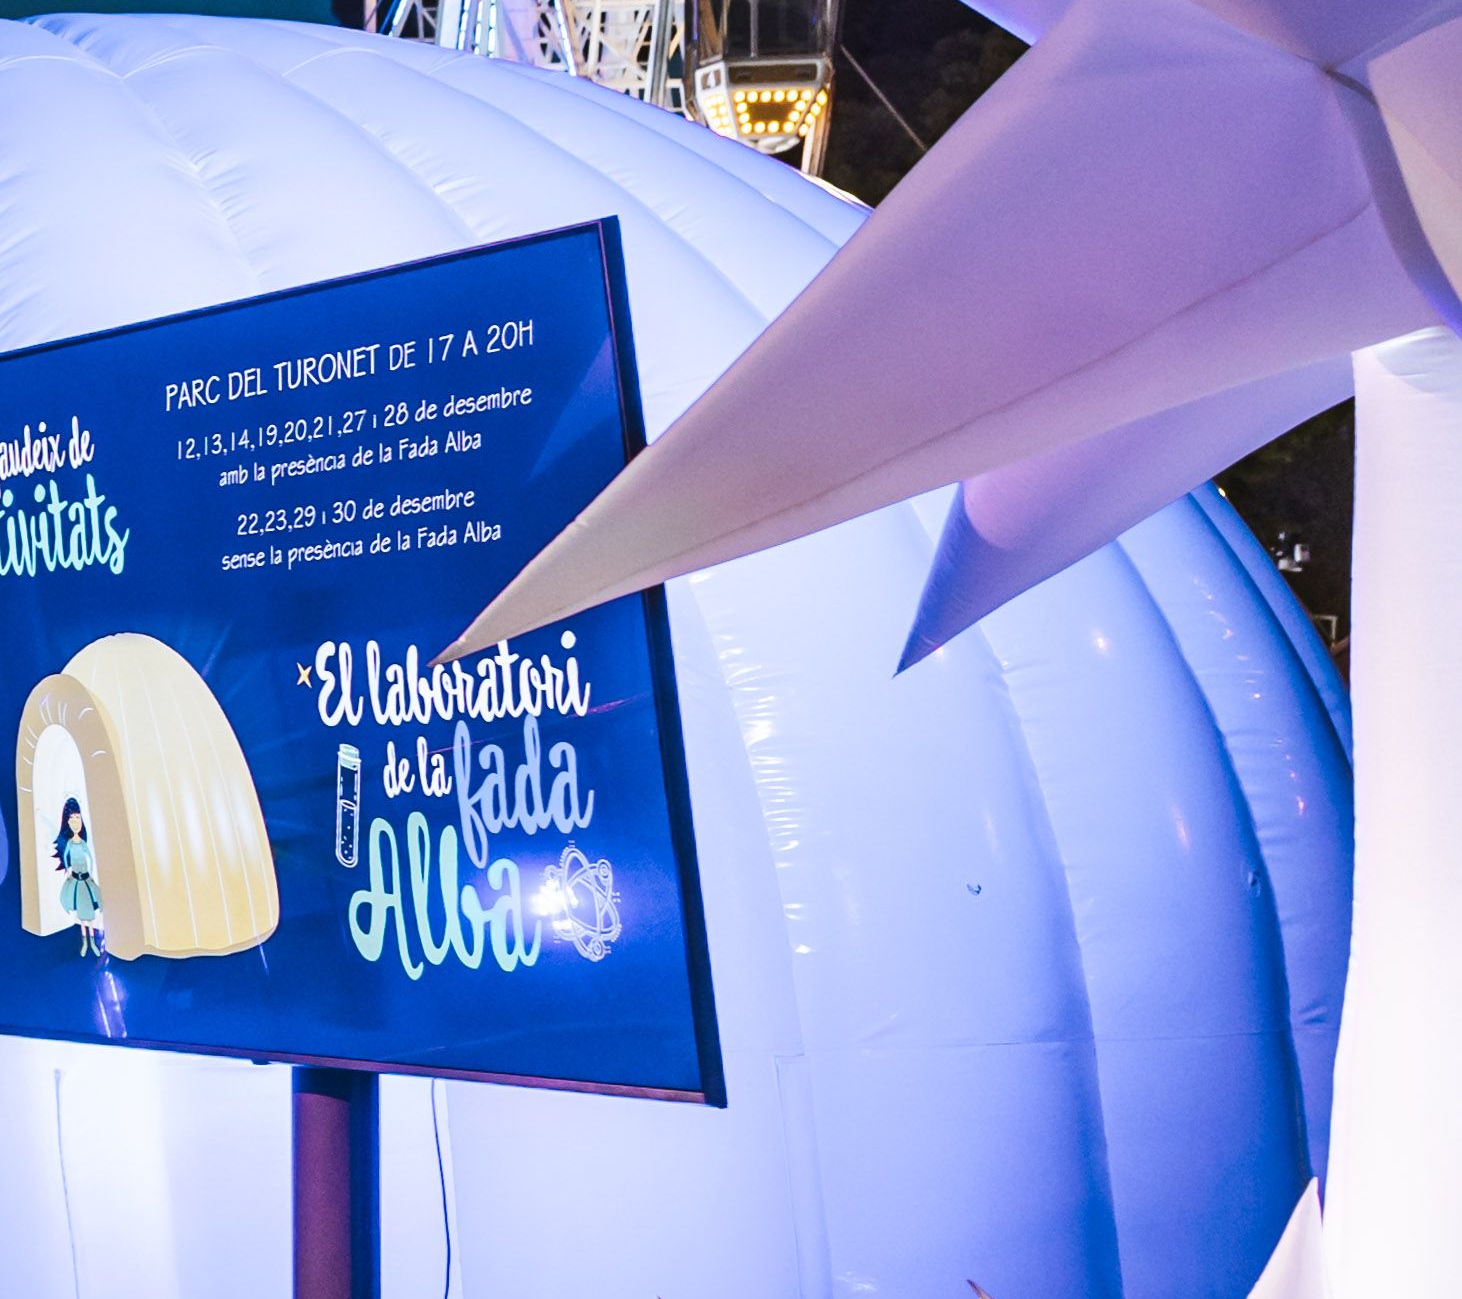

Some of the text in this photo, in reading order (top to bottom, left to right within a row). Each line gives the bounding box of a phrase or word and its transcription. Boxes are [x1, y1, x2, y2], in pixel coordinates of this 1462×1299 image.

[165, 318, 534, 412] PARC DEL TURONET DE 17 A 20H
[69, 415, 95, 469] de
[177, 409, 367, 460] 12,13,14,19,20,21,27
[383, 401, 409, 427] 28
[414, 399, 438, 422] de
[442, 386, 533, 417] desembre
[219, 429, 482, 487] amb la presència de la Fada Alba
[237, 505, 317, 537] 22,23,29
[332, 499, 357, 524] 30
[362, 498, 385, 520] de
[389, 487, 476, 517] desembre
[221, 520, 502, 571] sense la presència de la Fada Alba
[315, 630, 591, 727] El laboratori
[383, 741, 416, 799] de
[416, 736, 452, 798] la
[348, 811, 543, 981] Alba
